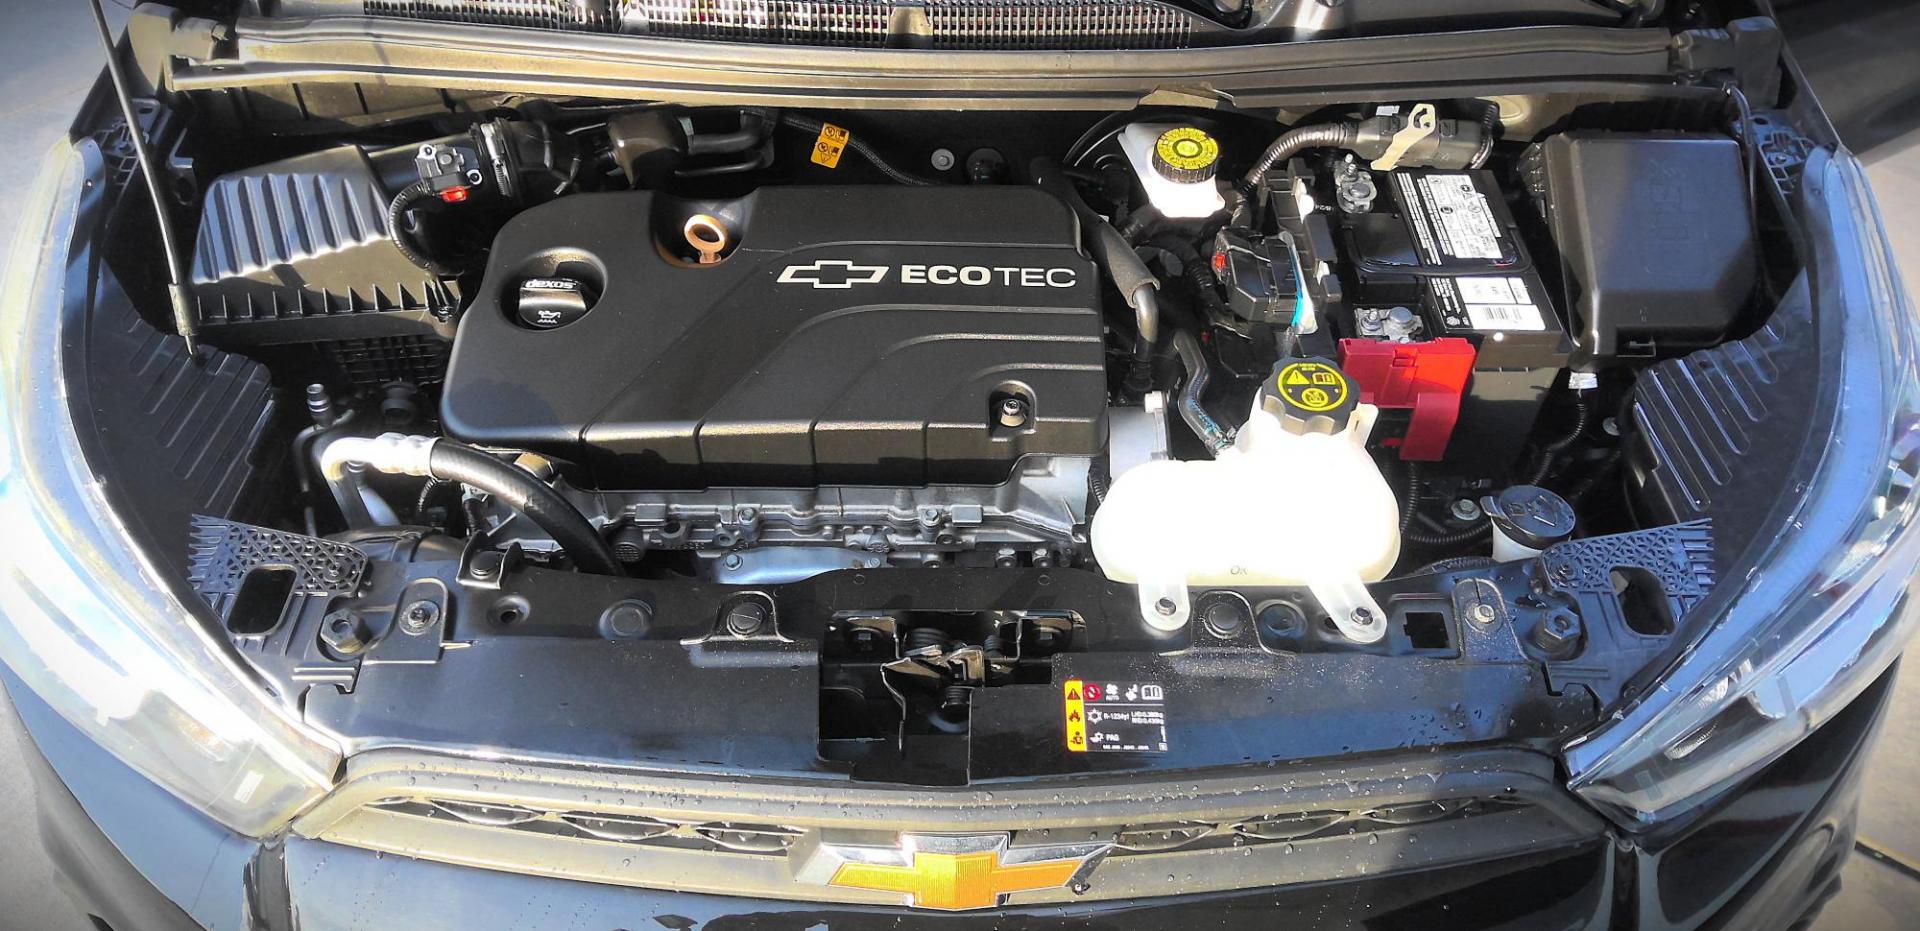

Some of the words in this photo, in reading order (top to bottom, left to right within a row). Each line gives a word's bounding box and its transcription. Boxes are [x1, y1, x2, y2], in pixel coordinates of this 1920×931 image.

[901, 264, 1076, 288] ECOTEC
[525, 279, 577, 289] dexos
[1103, 712, 1129, 720] R-1234yf
[1106, 733, 1120, 742] PAG
